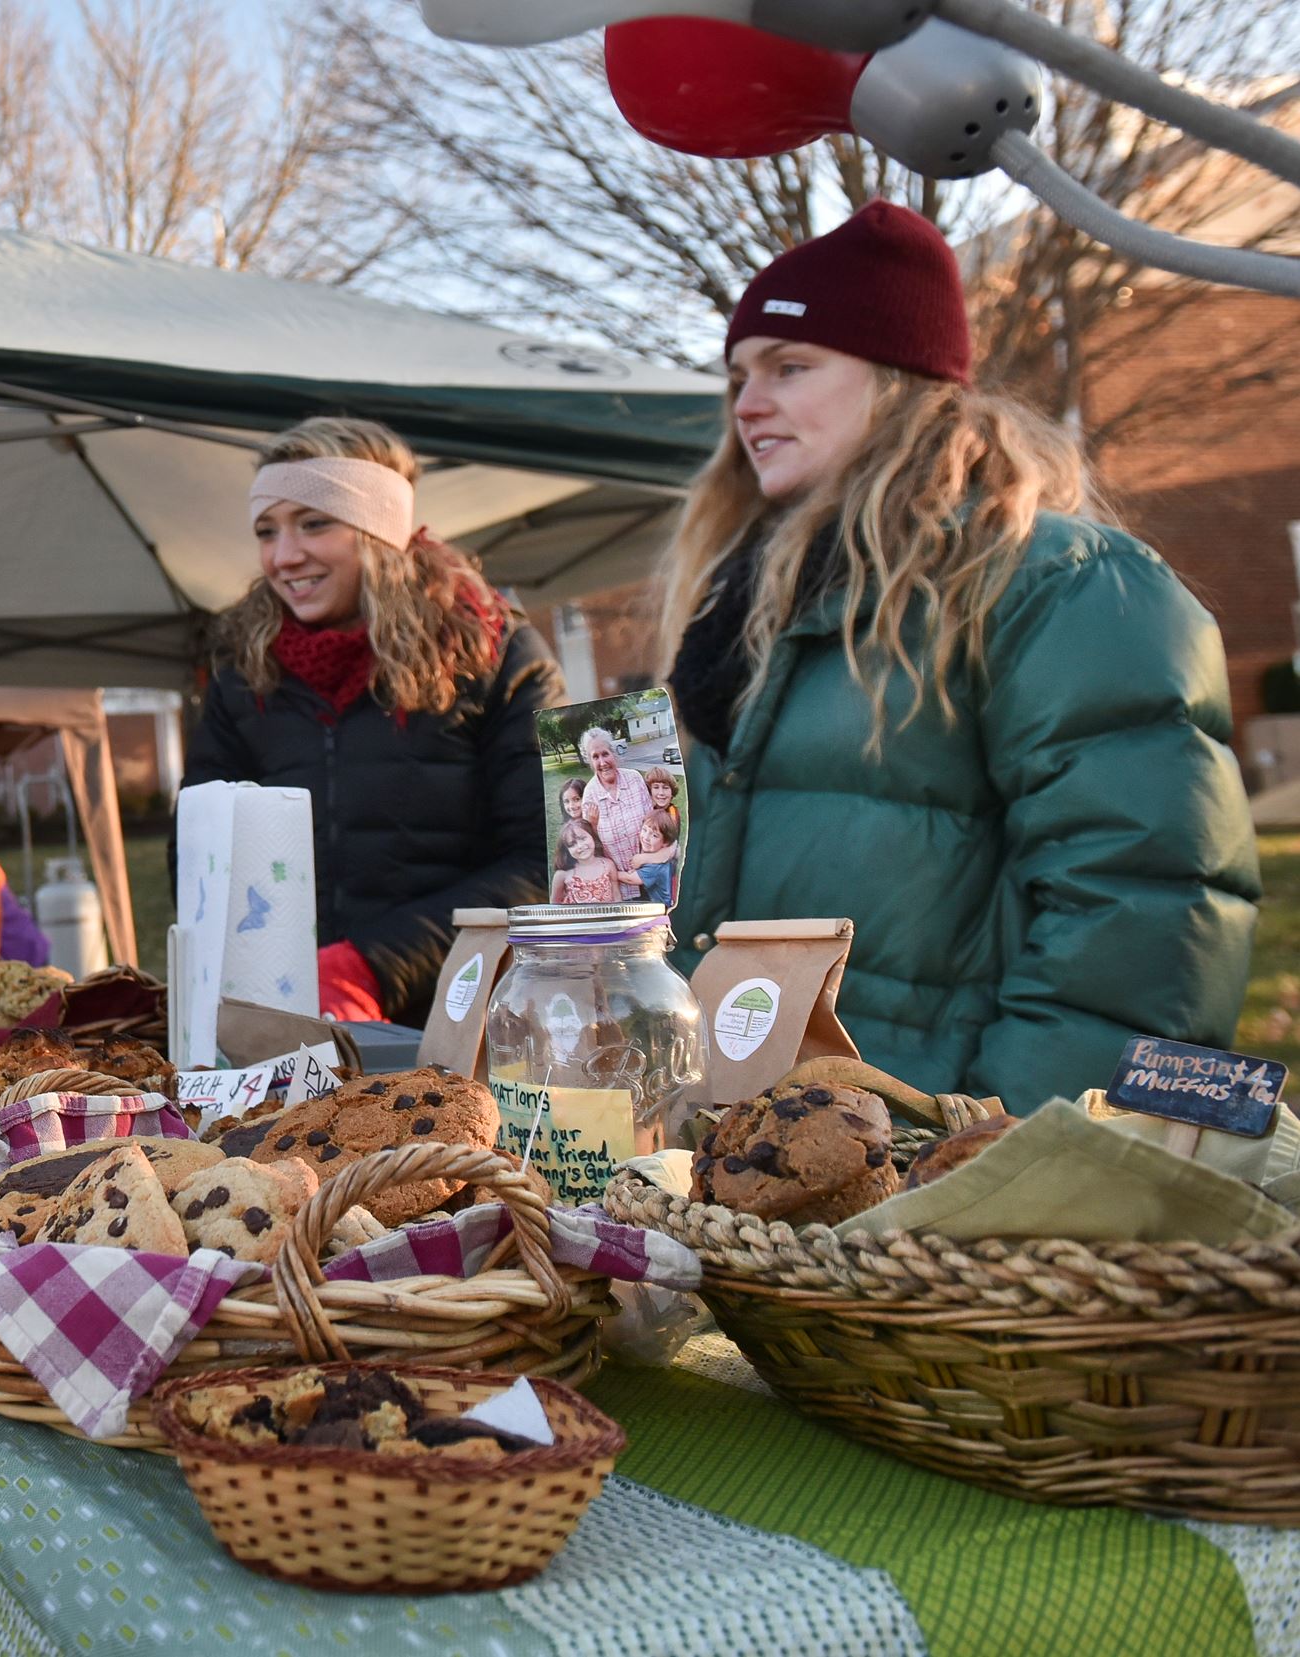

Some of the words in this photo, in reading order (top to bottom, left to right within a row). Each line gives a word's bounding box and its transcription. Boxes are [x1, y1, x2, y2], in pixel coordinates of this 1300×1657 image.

[551, 1128, 583, 1143] our
[557, 1139, 610, 1163] friend
[557, 1184, 607, 1199] cancer
